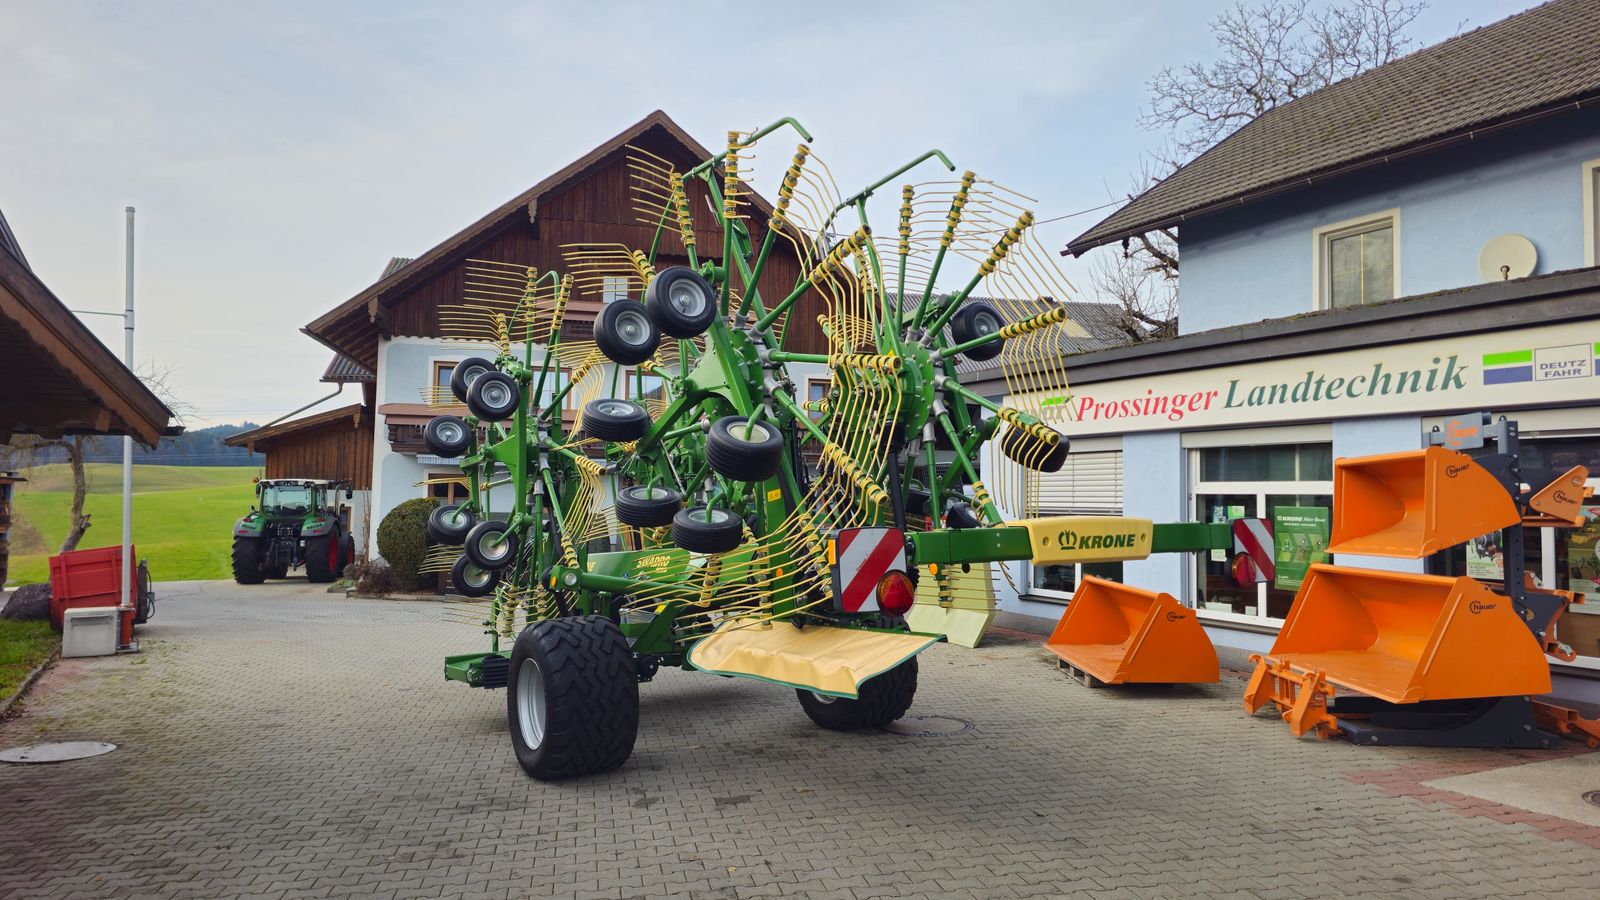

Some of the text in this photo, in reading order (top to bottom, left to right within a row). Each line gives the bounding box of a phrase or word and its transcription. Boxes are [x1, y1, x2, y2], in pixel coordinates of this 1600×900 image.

[1540, 360, 1586, 370] DEUTZ
[1544, 368, 1582, 378] FAHR
[1077, 355, 1469, 421] Prossinger Landtechnik
[1448, 464, 1469, 476] hauer
[1556, 492, 1576, 504] hauer
[1078, 533, 1136, 550] KRONE
[1470, 602, 1496, 611] hauer
